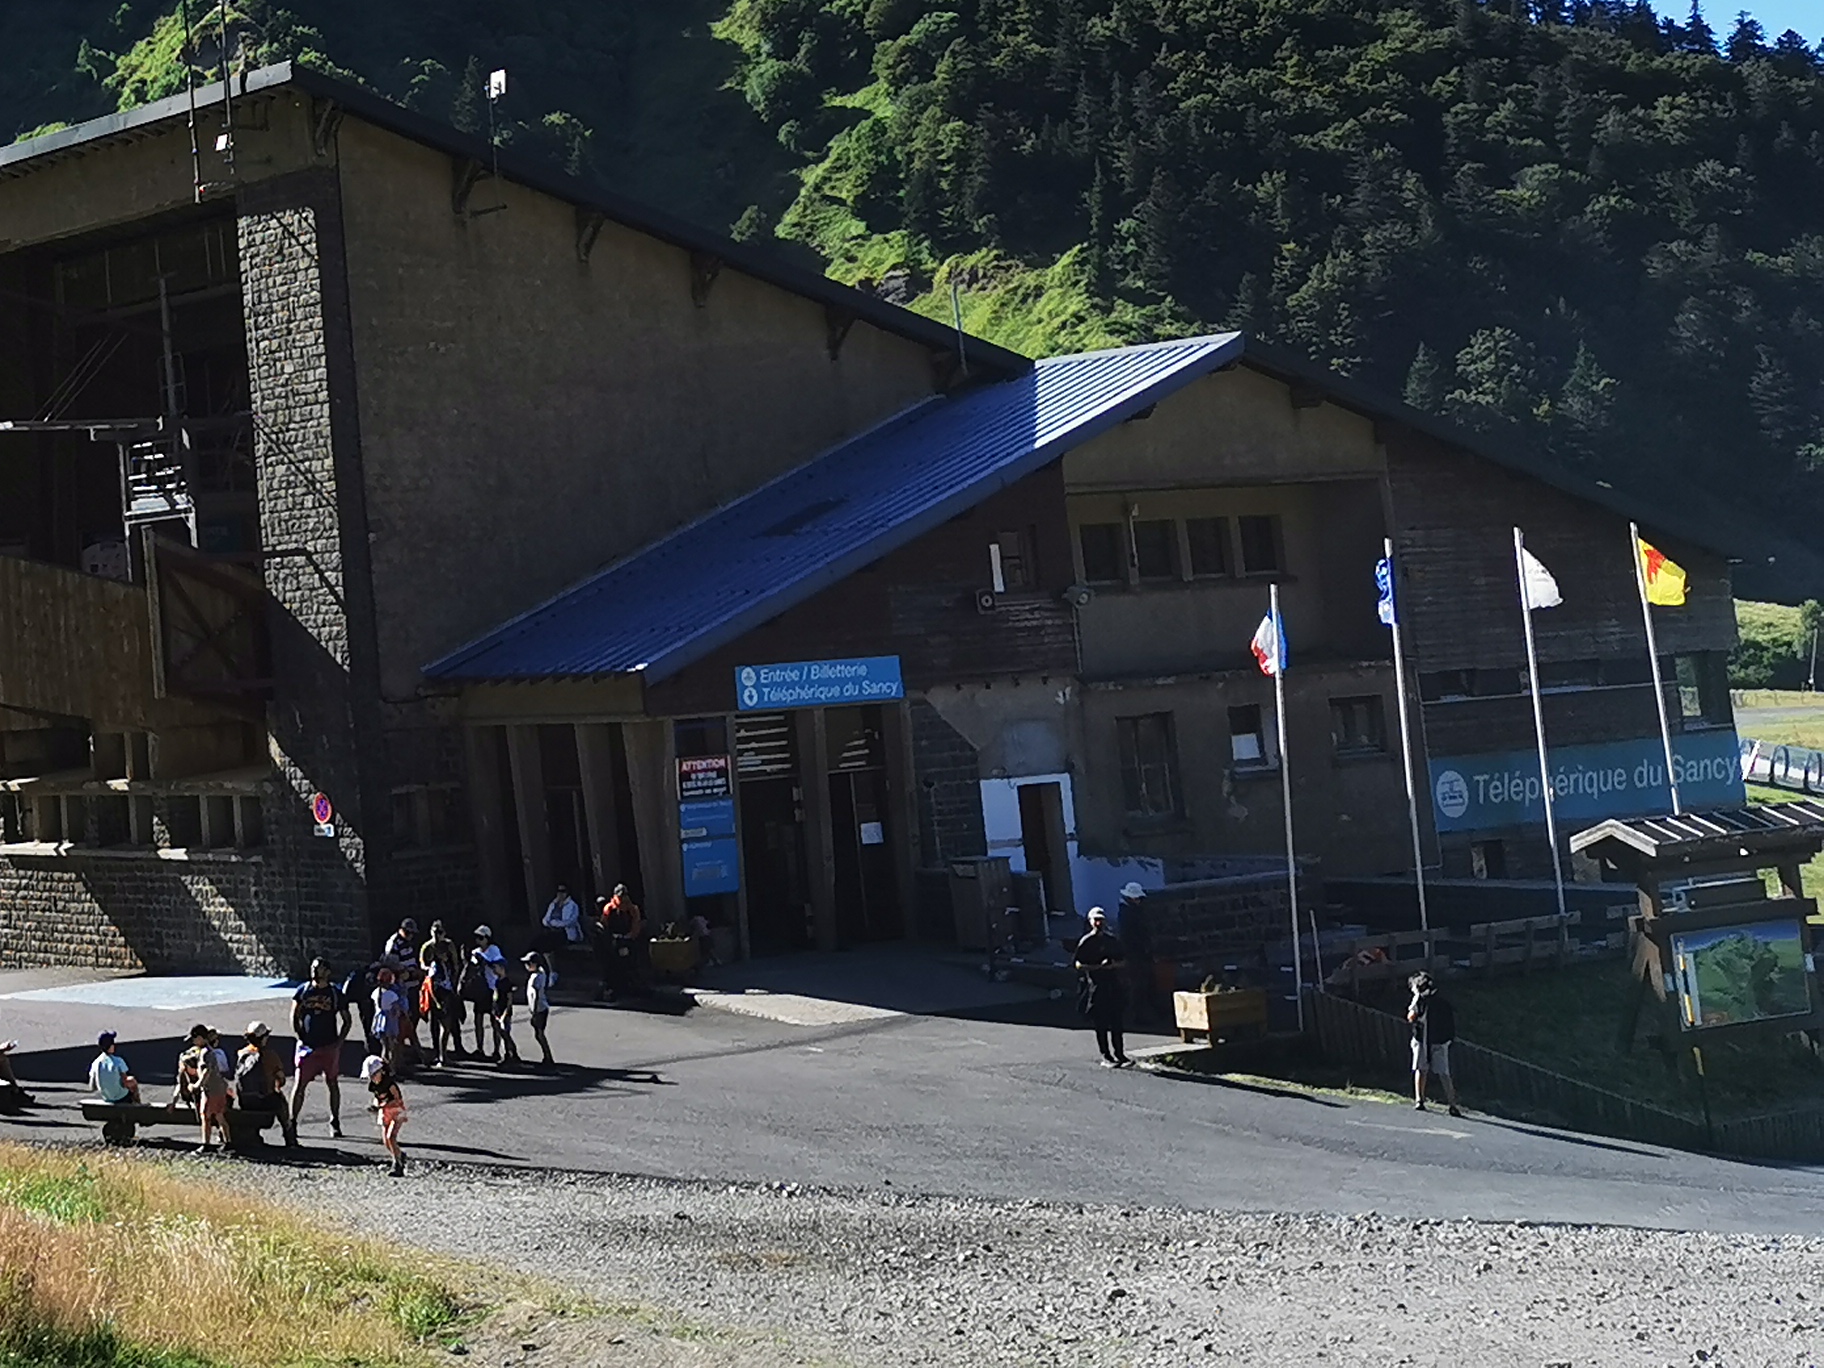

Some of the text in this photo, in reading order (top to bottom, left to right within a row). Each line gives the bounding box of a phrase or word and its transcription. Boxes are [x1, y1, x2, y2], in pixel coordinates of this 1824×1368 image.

[760, 666, 800, 683] Entrée
[811, 662, 868, 680] Billetterie
[762, 679, 900, 703] Téléphérique du Sancy
[1634, 759, 1664, 789] du
[1672, 754, 1739, 787] Sancy
